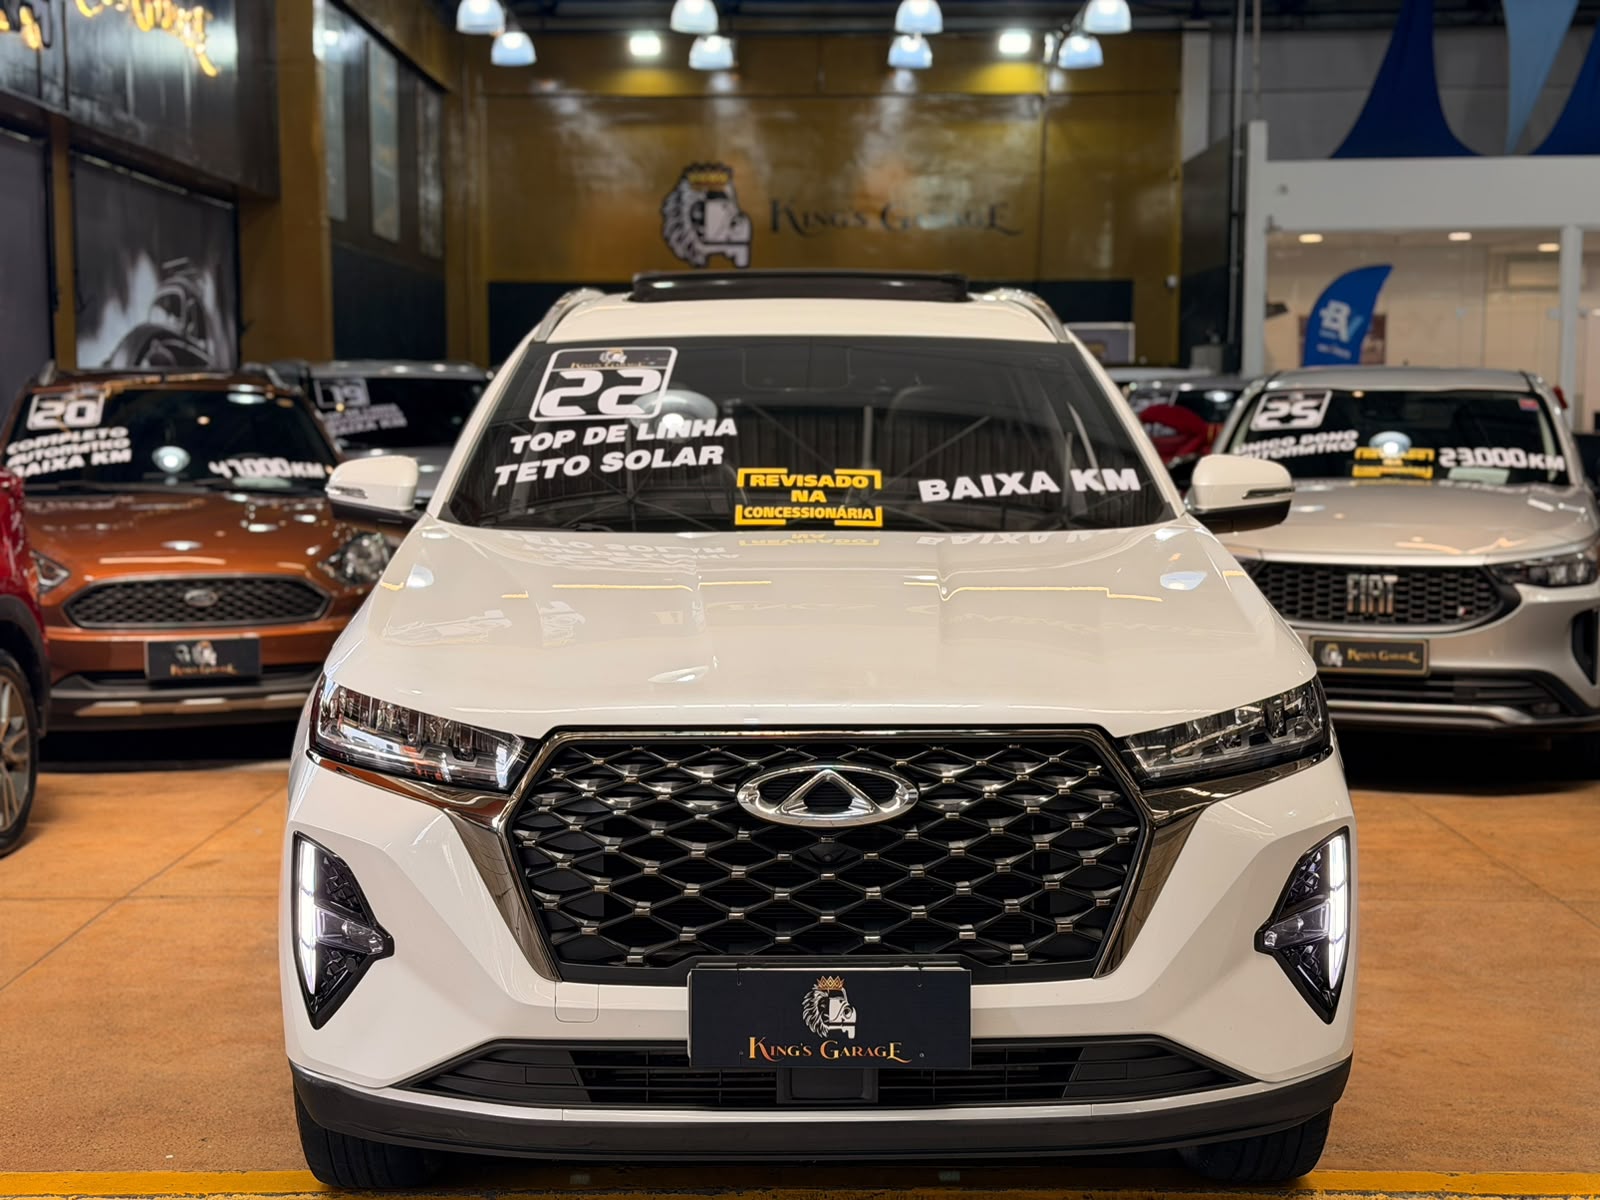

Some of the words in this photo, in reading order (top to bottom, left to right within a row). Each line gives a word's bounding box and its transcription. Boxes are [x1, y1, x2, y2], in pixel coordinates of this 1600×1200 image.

[879, 202, 1024, 236] GAAGE
[538, 370, 662, 416] 22
[32, 400, 100, 429] 20
[1258, 400, 1321, 428] 25
[510, 430, 576, 454] TOP
[582, 424, 629, 446] DE
[636, 418, 738, 441] LINHA
[90, 448, 133, 467] KM
[495, 455, 591, 486] TETO
[600, 445, 725, 473] SOLAR
[749, 474, 869, 489] REVISADO
[917, 471, 1061, 503] BAIXA
[1069, 468, 1142, 492] KM
[790, 490, 828, 503] NA
[743, 504, 874, 520] CONCESSIONÁRIA
[1346, 573, 1398, 614] FIAT
[748, 1036, 813, 1062] KING'S
[819, 1039, 913, 1064] GARAGE
